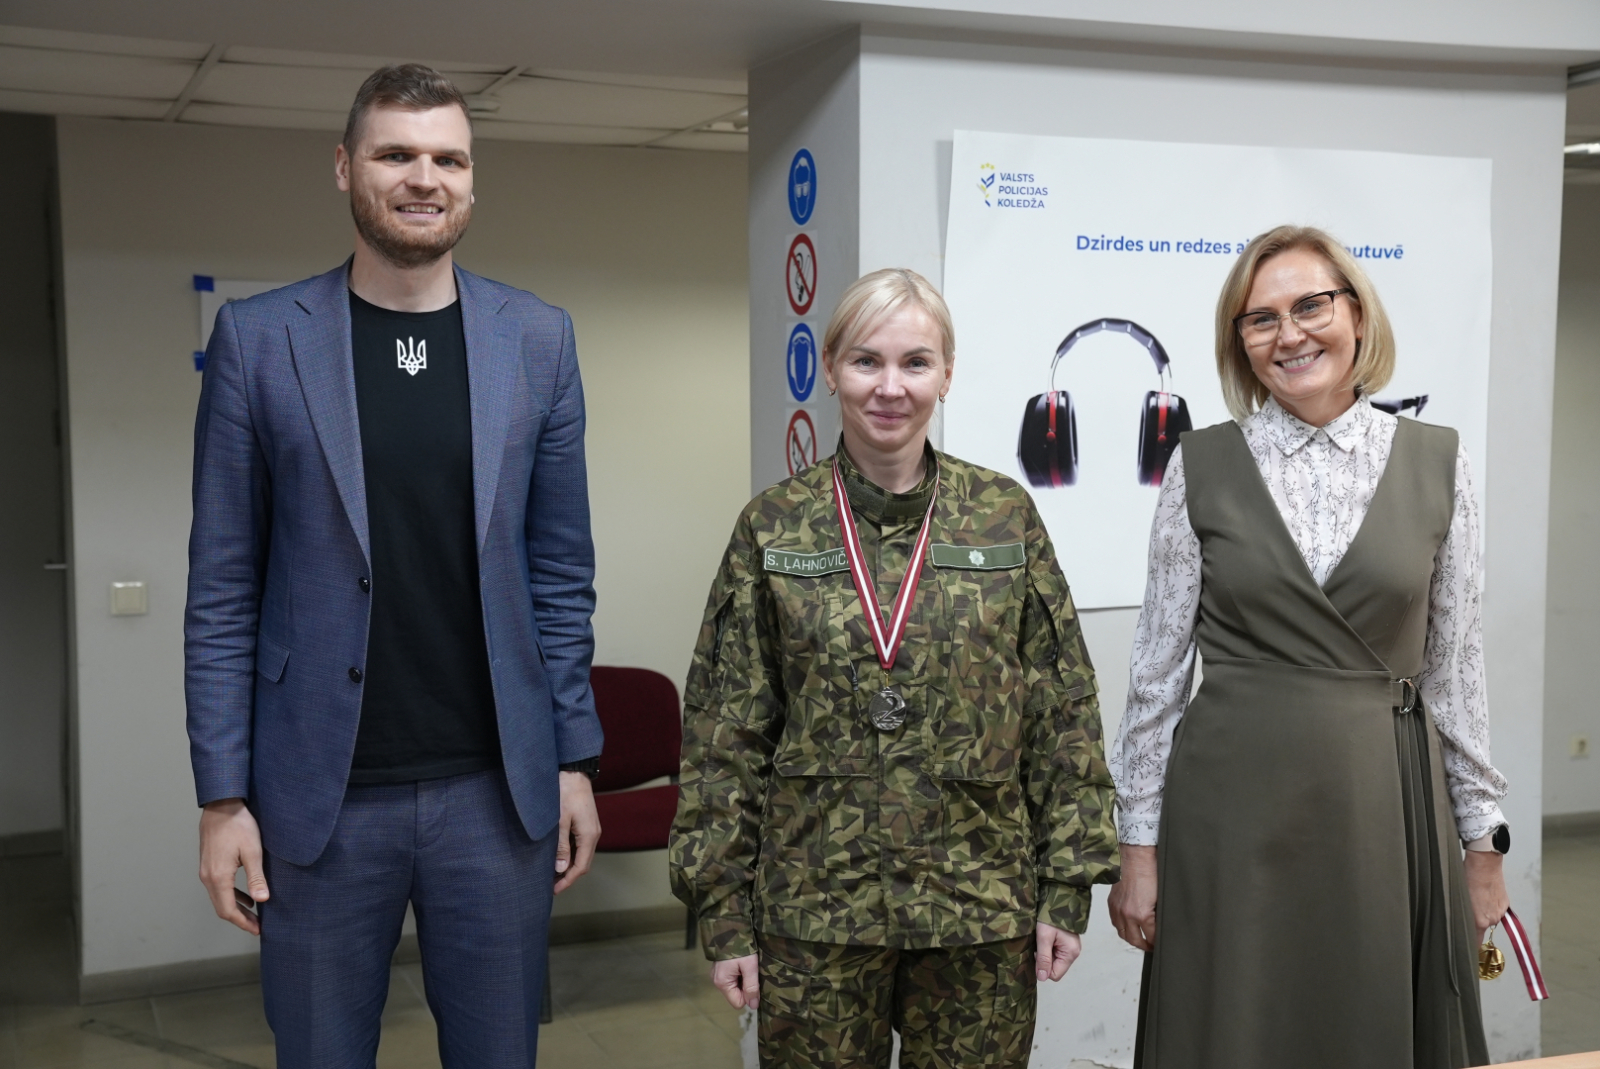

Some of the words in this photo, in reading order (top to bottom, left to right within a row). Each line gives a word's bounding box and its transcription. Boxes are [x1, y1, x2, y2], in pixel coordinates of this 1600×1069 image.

[999, 172, 1035, 183] VALSTS
[998, 185, 1049, 196] POLICIJAS
[997, 198, 1045, 209] KOLEDŽA
[1076, 234, 1144, 252] Dzirdes
[1149, 240, 1171, 253] un
[1176, 238, 1232, 254] redzes
[767, 554, 779, 567] S.
[784, 550, 849, 572] ĻAHNOVIČ
